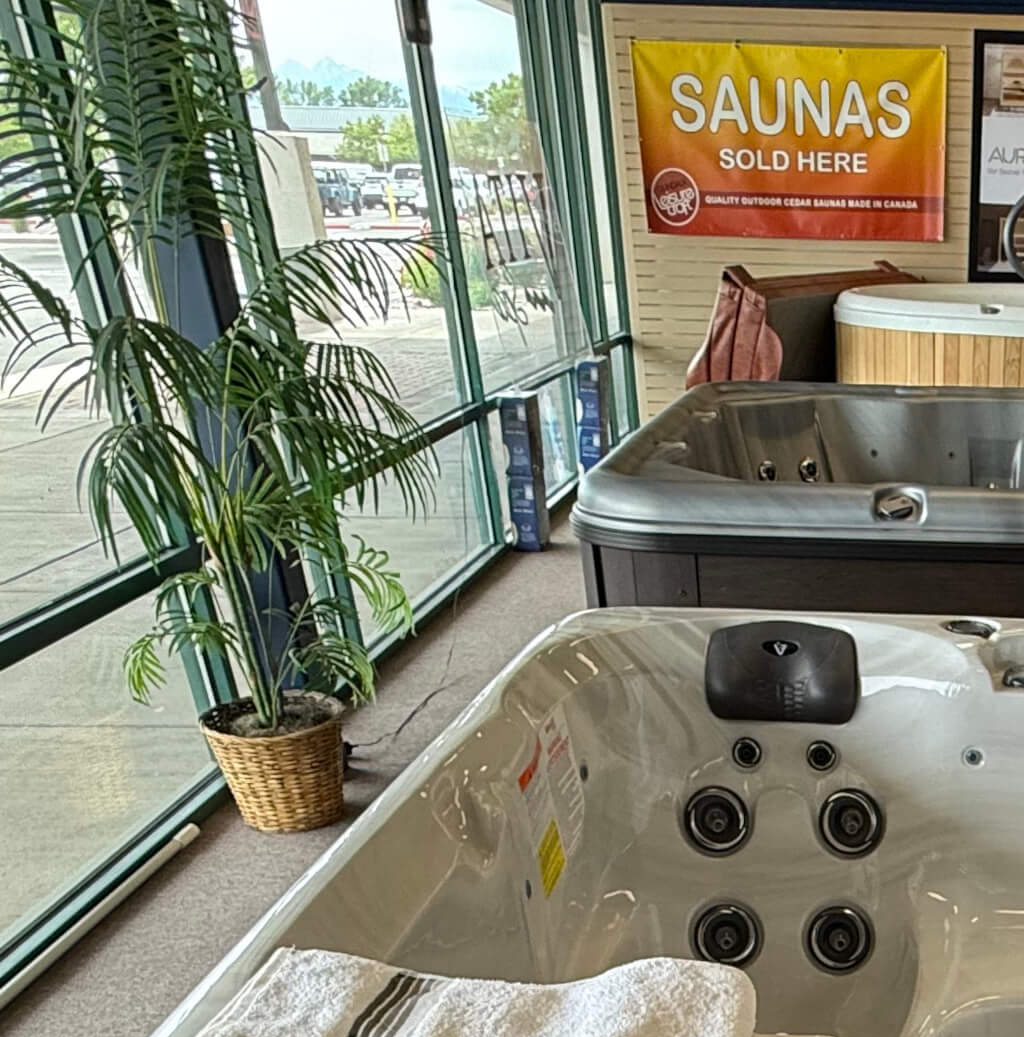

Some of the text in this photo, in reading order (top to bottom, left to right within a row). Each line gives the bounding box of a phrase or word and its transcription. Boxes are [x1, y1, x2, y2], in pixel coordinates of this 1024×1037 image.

[671, 73, 911, 138] SAUNAS
[719, 148, 868, 173] SOLD HERE
[704, 195, 918, 209] QUALITY OUTDOOR CEDAR SAUNAS MADE IN CANADA
